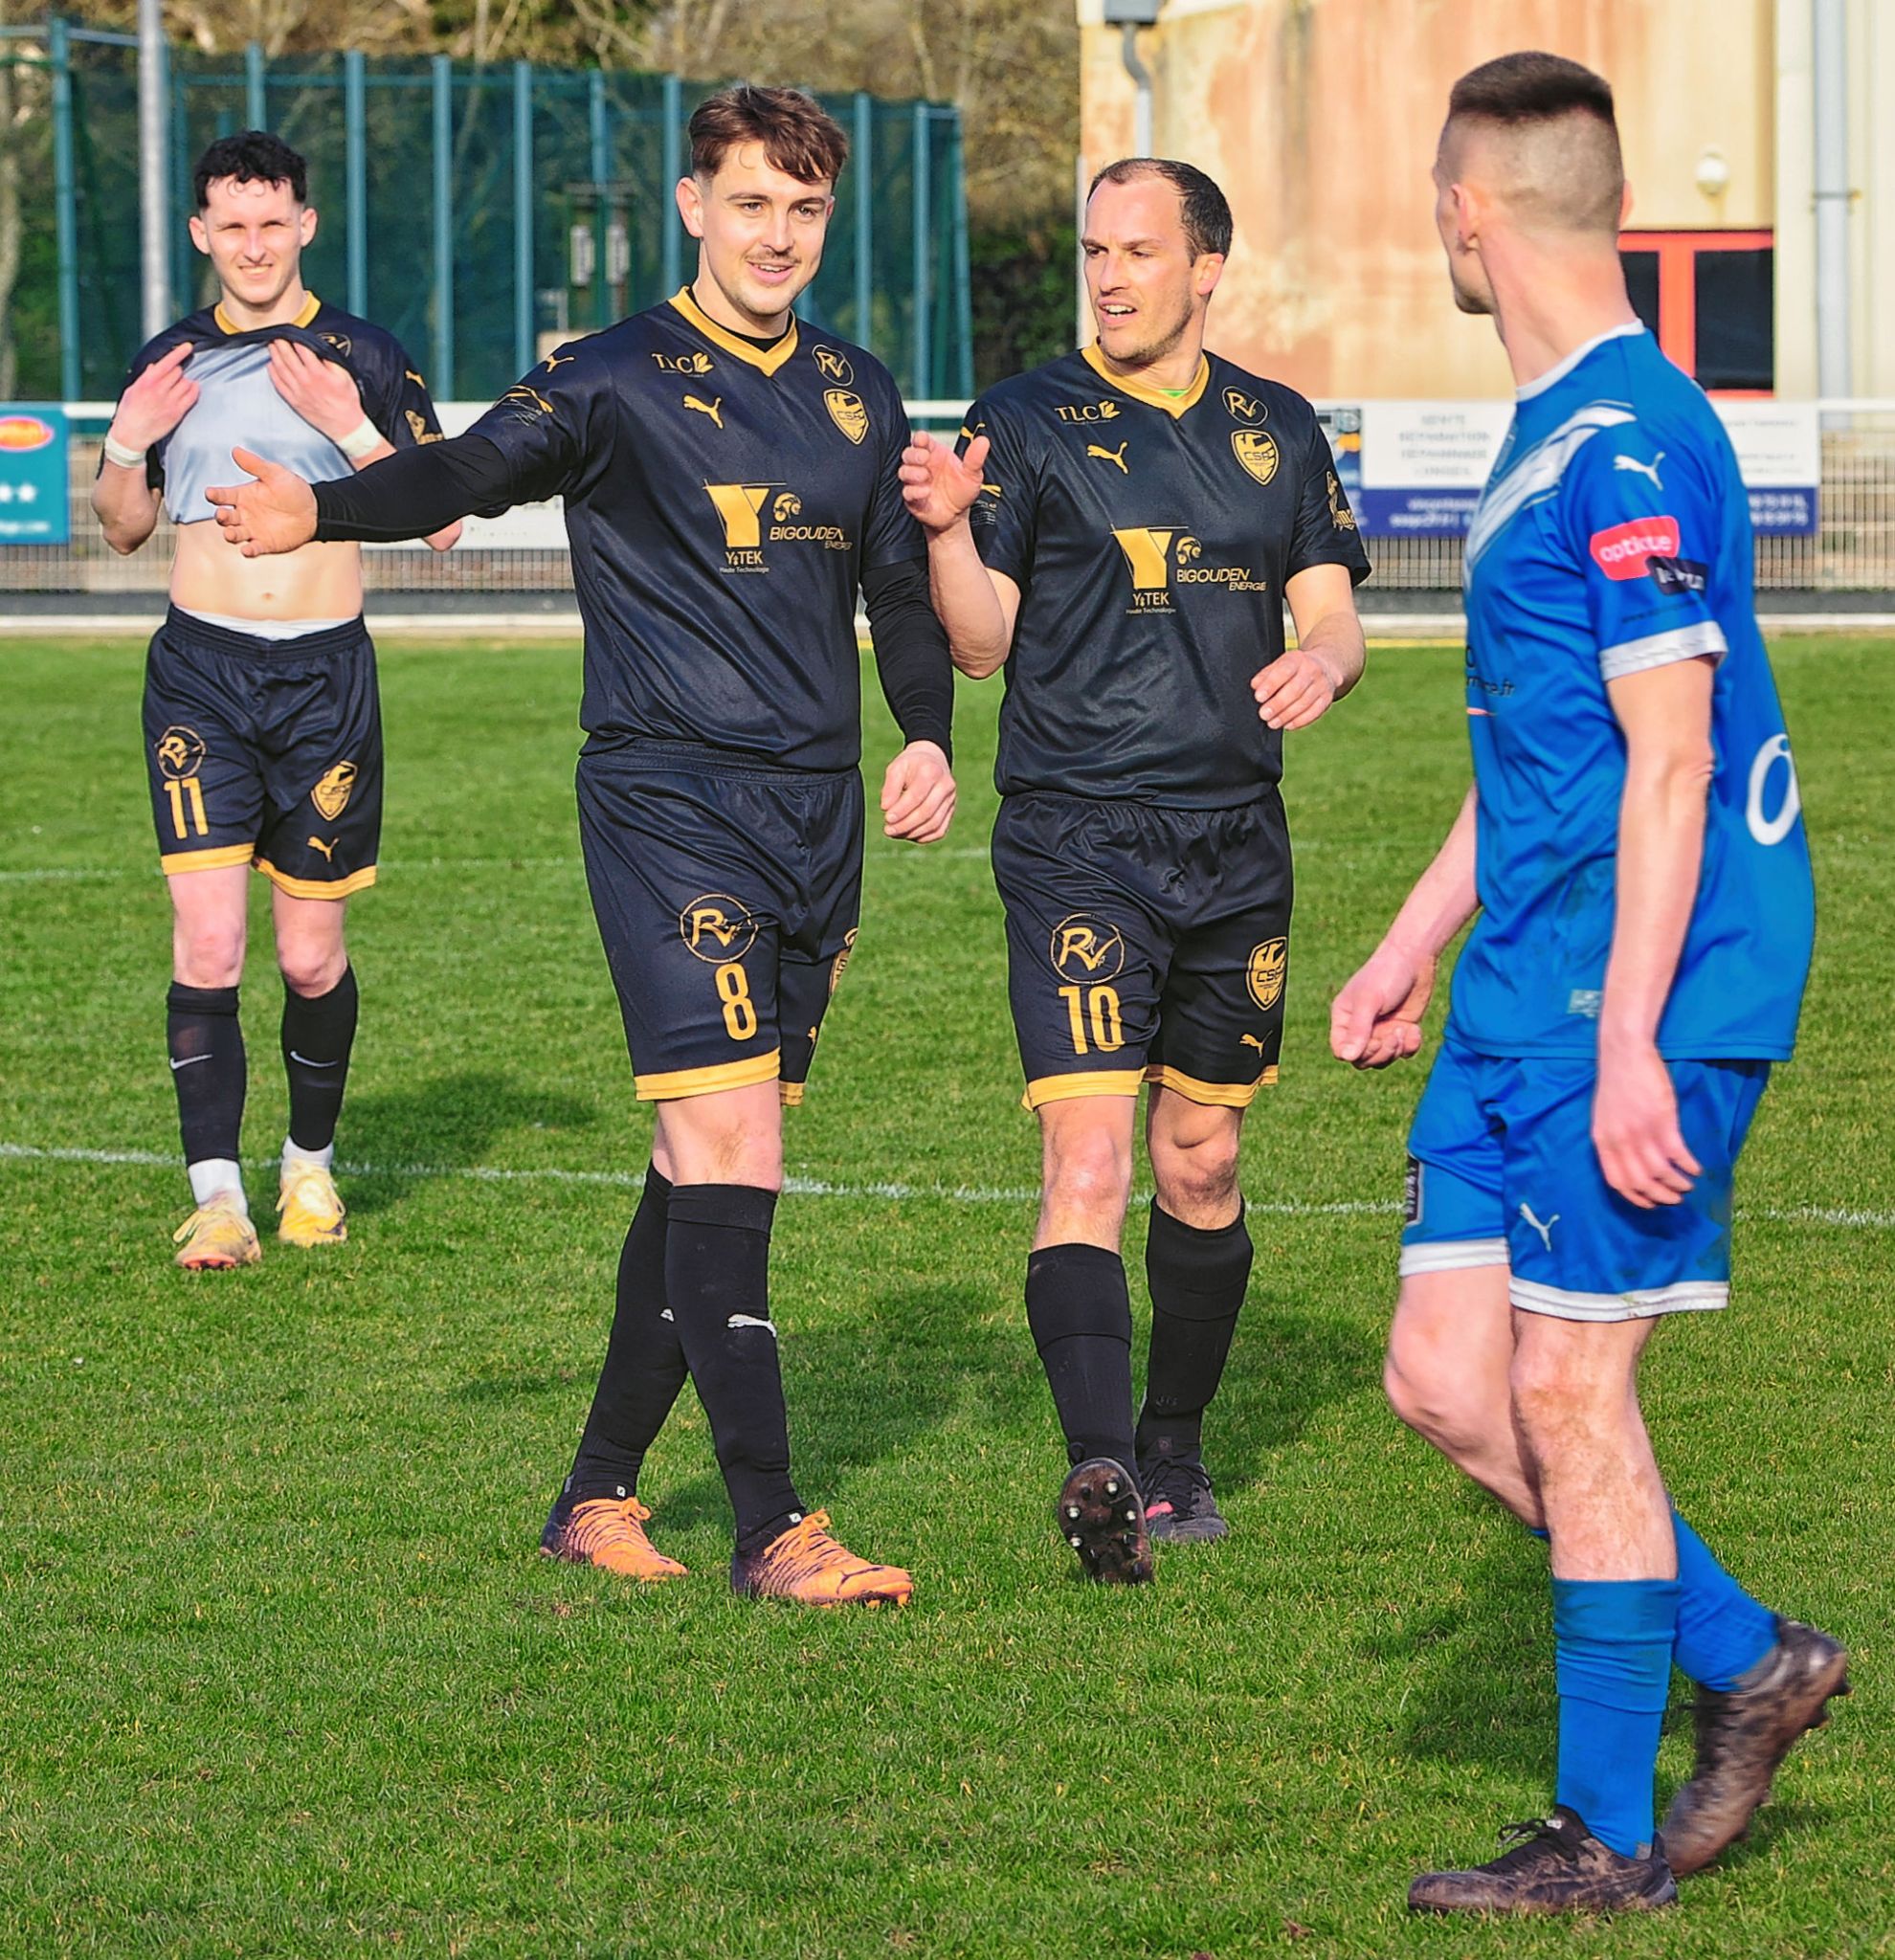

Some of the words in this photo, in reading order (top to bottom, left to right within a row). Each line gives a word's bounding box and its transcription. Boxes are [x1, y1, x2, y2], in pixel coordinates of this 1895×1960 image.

[1054, 405, 1101, 422] TLC
[769, 525, 845, 543] BIGOUDEN
[1600, 534, 1673, 563] optique
[1176, 568, 1251, 583] BIGOUDEN
[163, 776, 209, 839] 11
[714, 962, 757, 1041] 8
[1058, 985, 1126, 1056] 10
